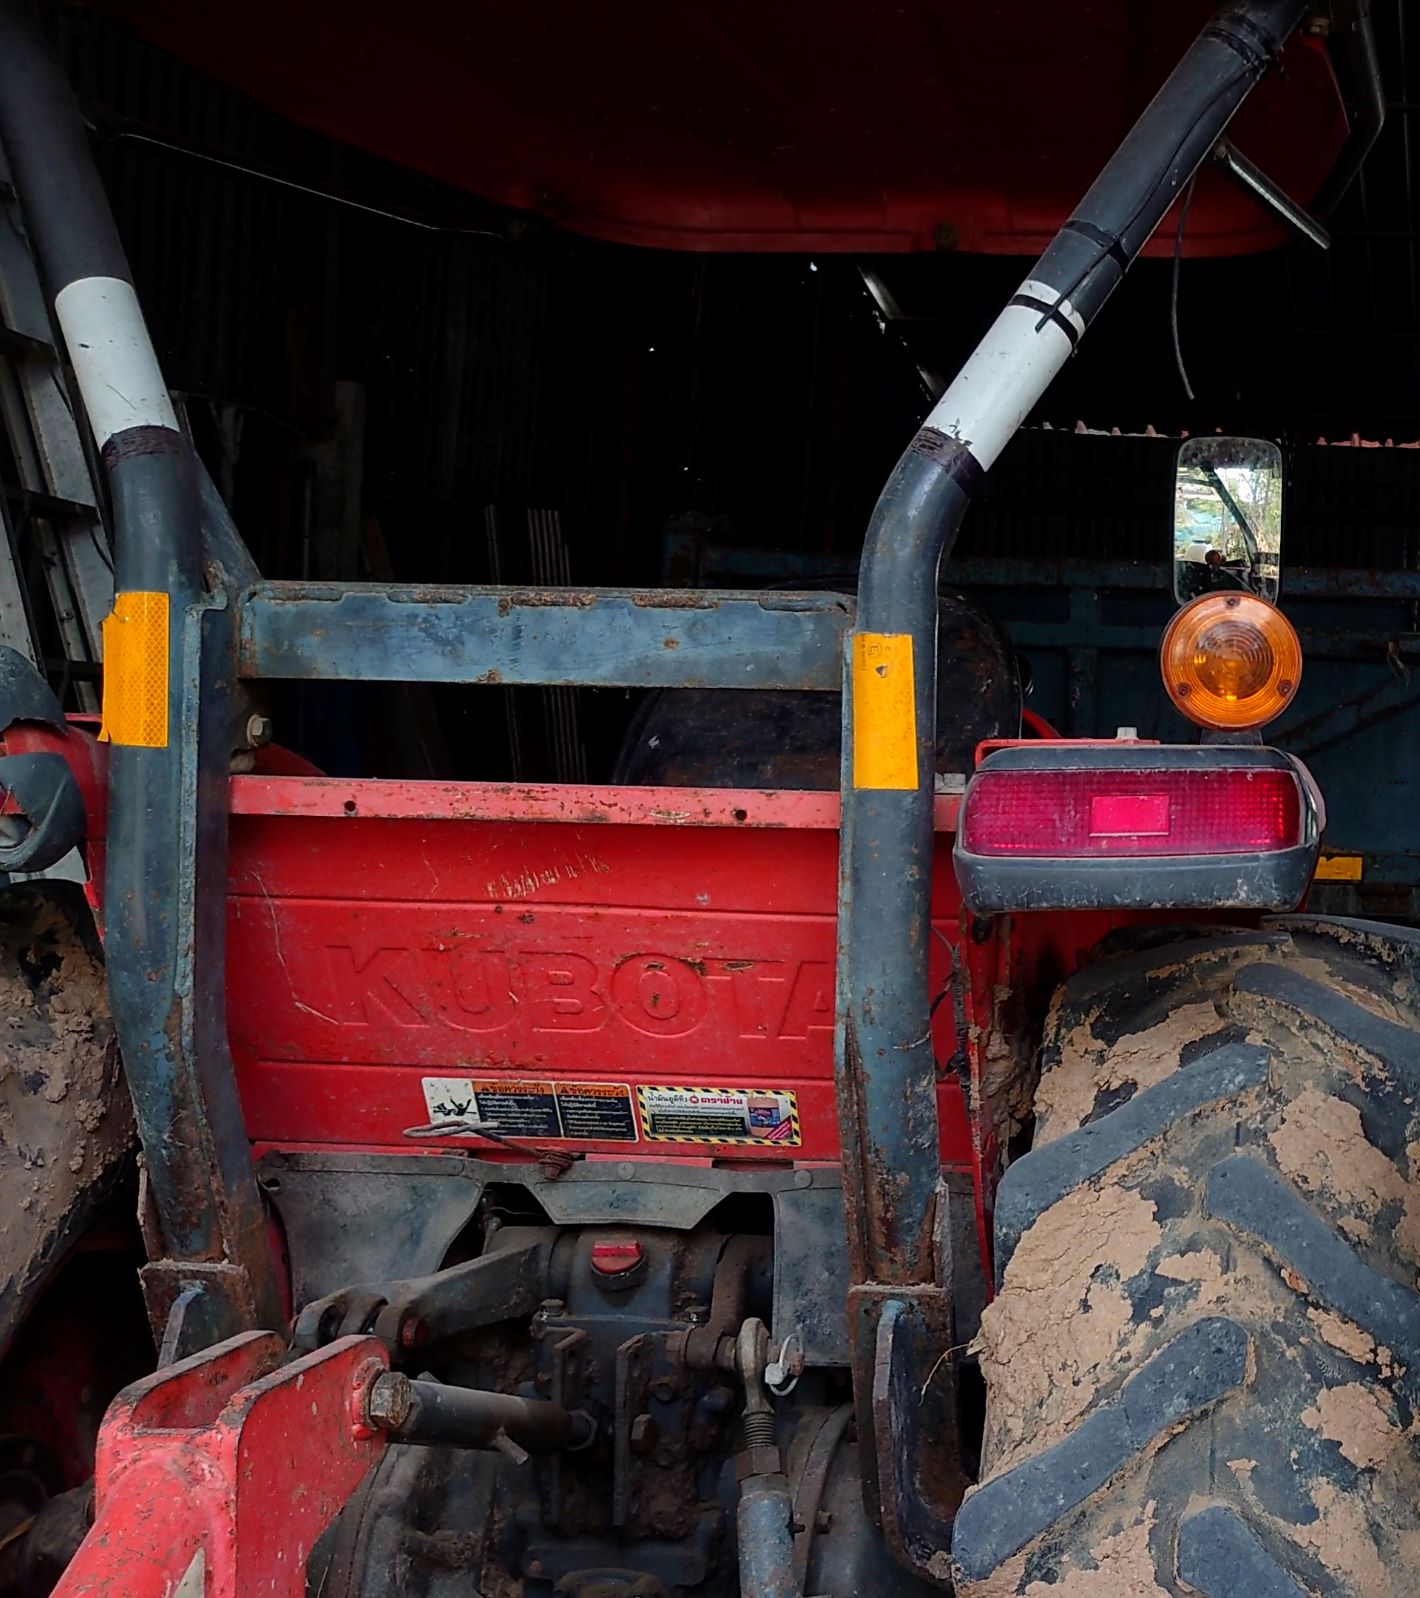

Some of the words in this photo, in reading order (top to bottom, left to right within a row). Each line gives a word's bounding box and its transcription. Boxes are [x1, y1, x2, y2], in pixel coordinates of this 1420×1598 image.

[322, 943, 836, 1040] KUBOTA
[569, 1085, 625, 1096] ข้อควรระวัง
